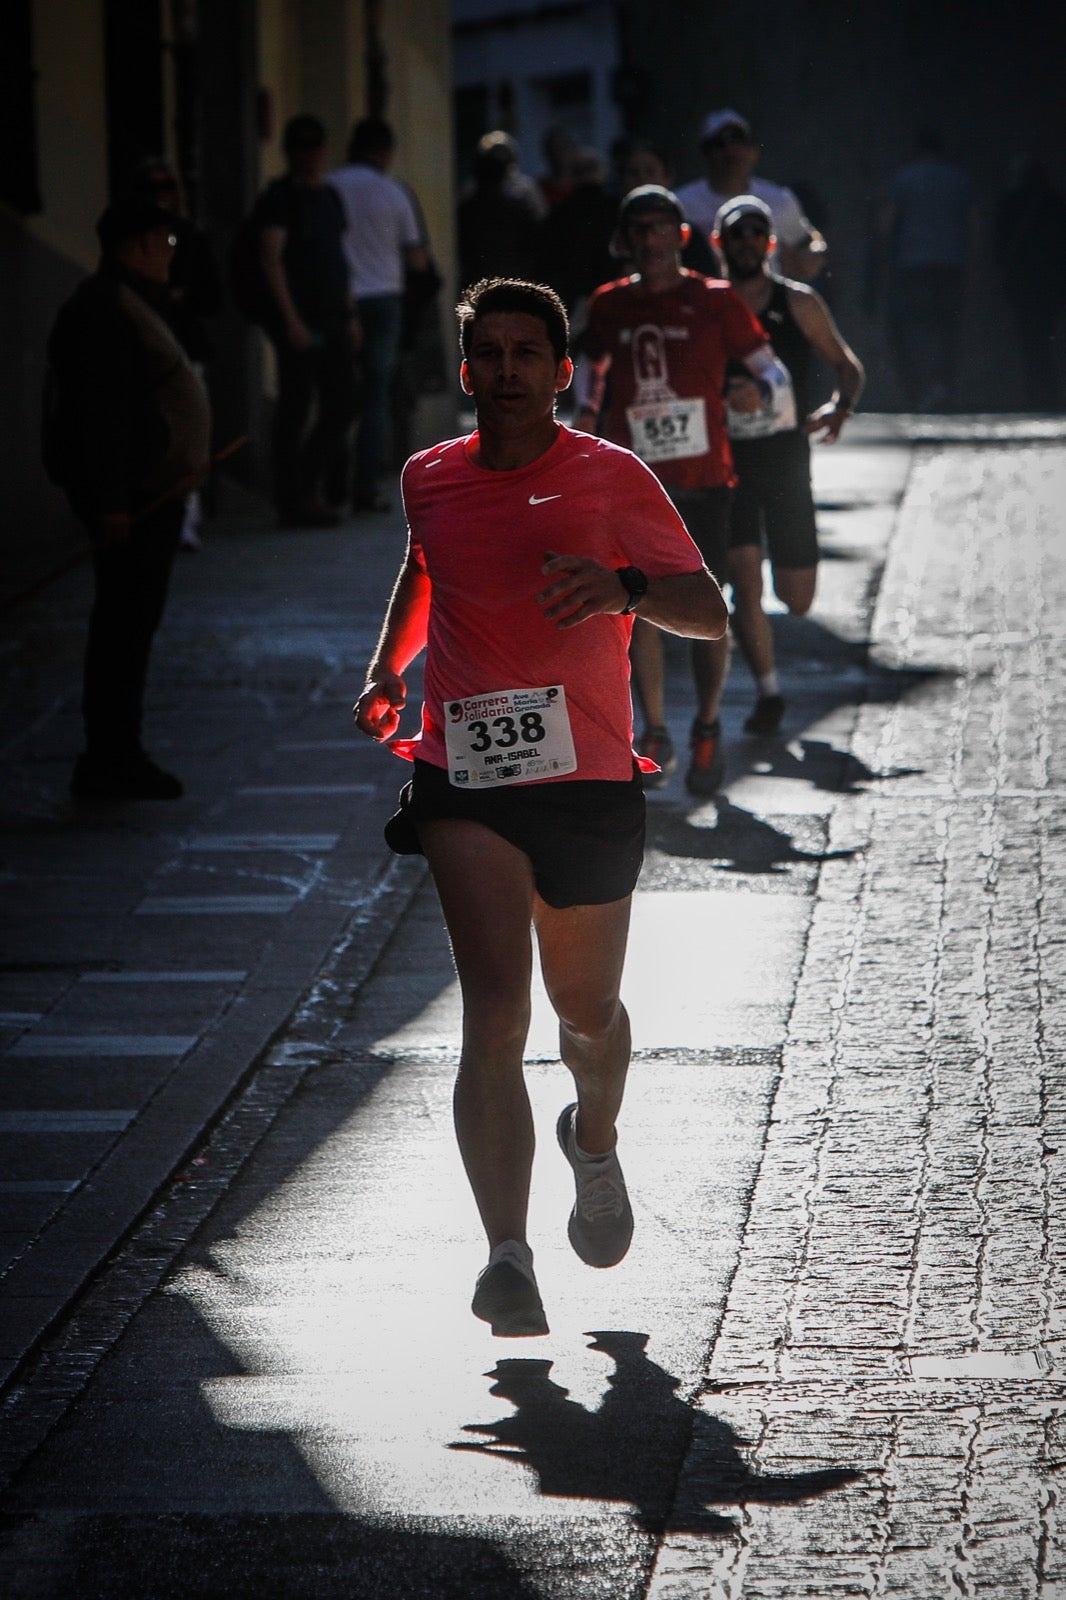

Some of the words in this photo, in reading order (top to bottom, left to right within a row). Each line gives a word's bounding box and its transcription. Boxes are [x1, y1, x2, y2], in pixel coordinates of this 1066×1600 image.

[644, 414, 690, 439] 557
[464, 696, 508, 711] Carrera
[514, 703, 551, 713] Granada
[464, 705, 514, 722] Solidaria
[467, 711, 546, 752] 338
[484, 748, 541, 765] ANA-ISABEL
